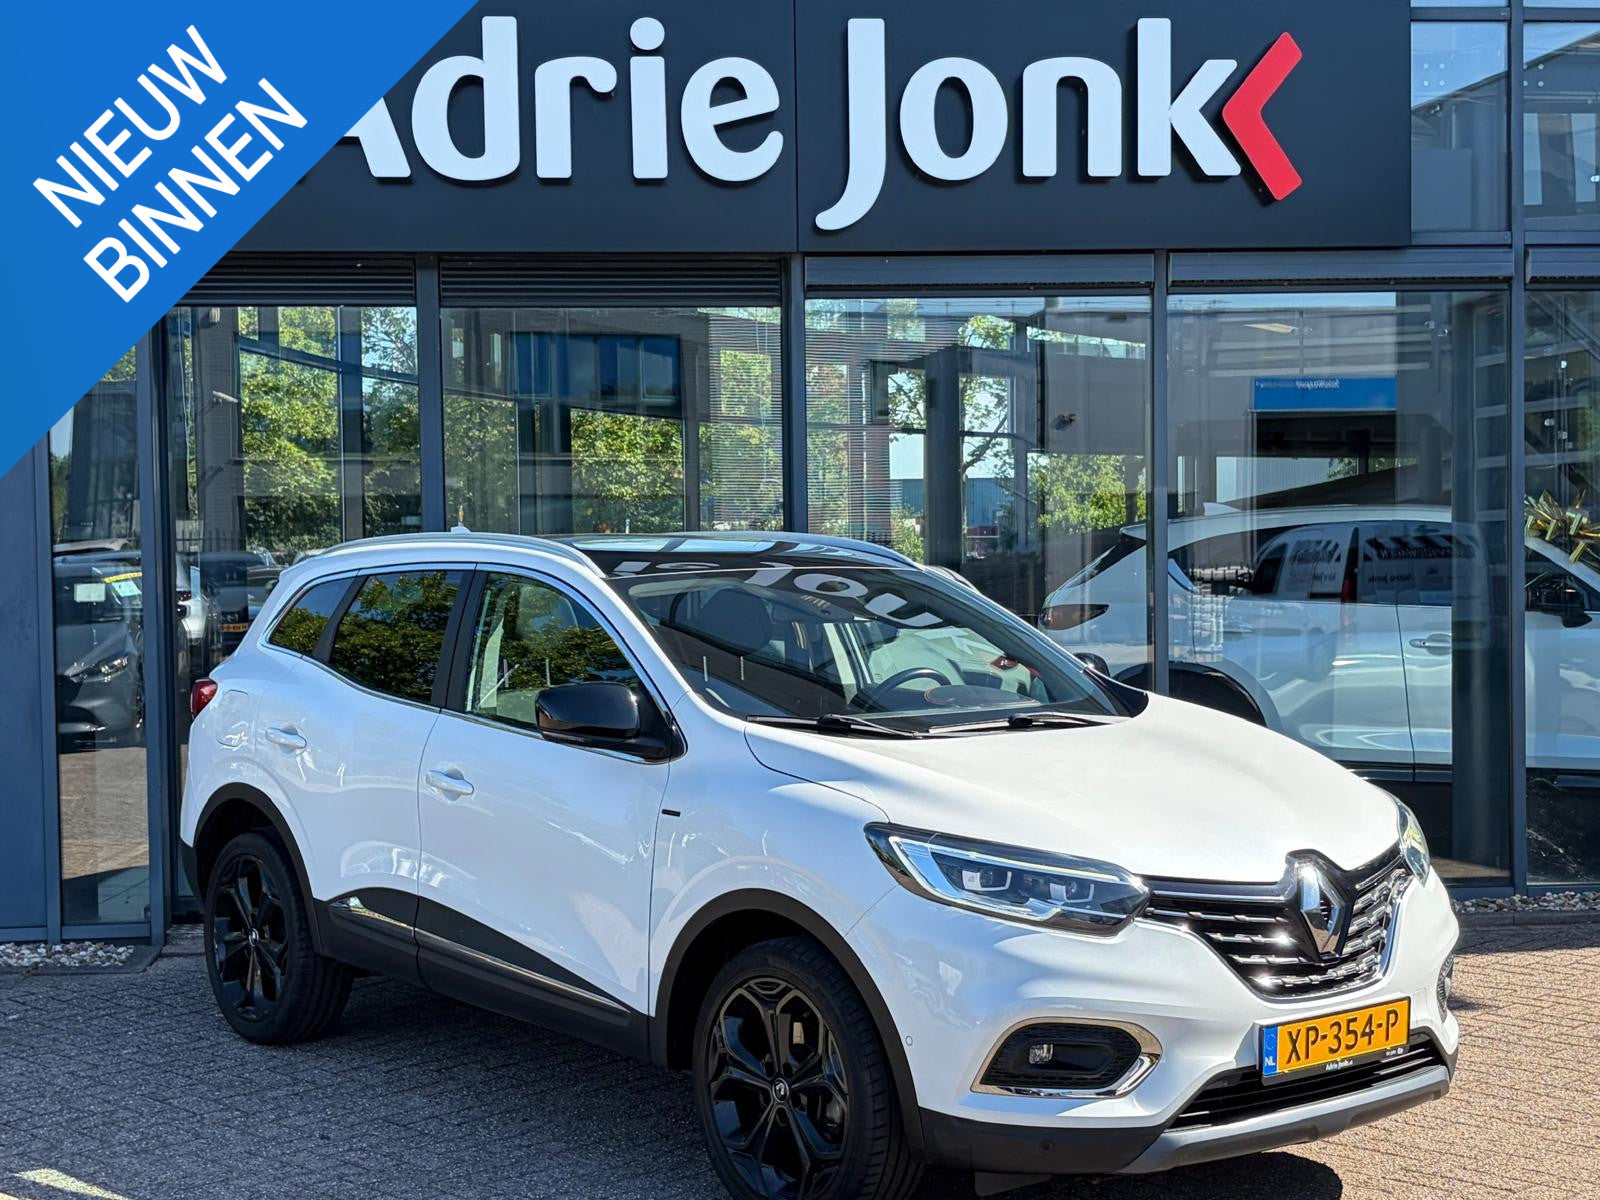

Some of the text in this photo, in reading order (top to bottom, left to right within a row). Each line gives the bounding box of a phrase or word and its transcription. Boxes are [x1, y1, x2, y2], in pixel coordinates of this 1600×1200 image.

[815, 17, 1241, 230] Jonk
[1264, 1056, 1276, 1067] NL
[1286, 1009, 1399, 1065] XP-354-P
